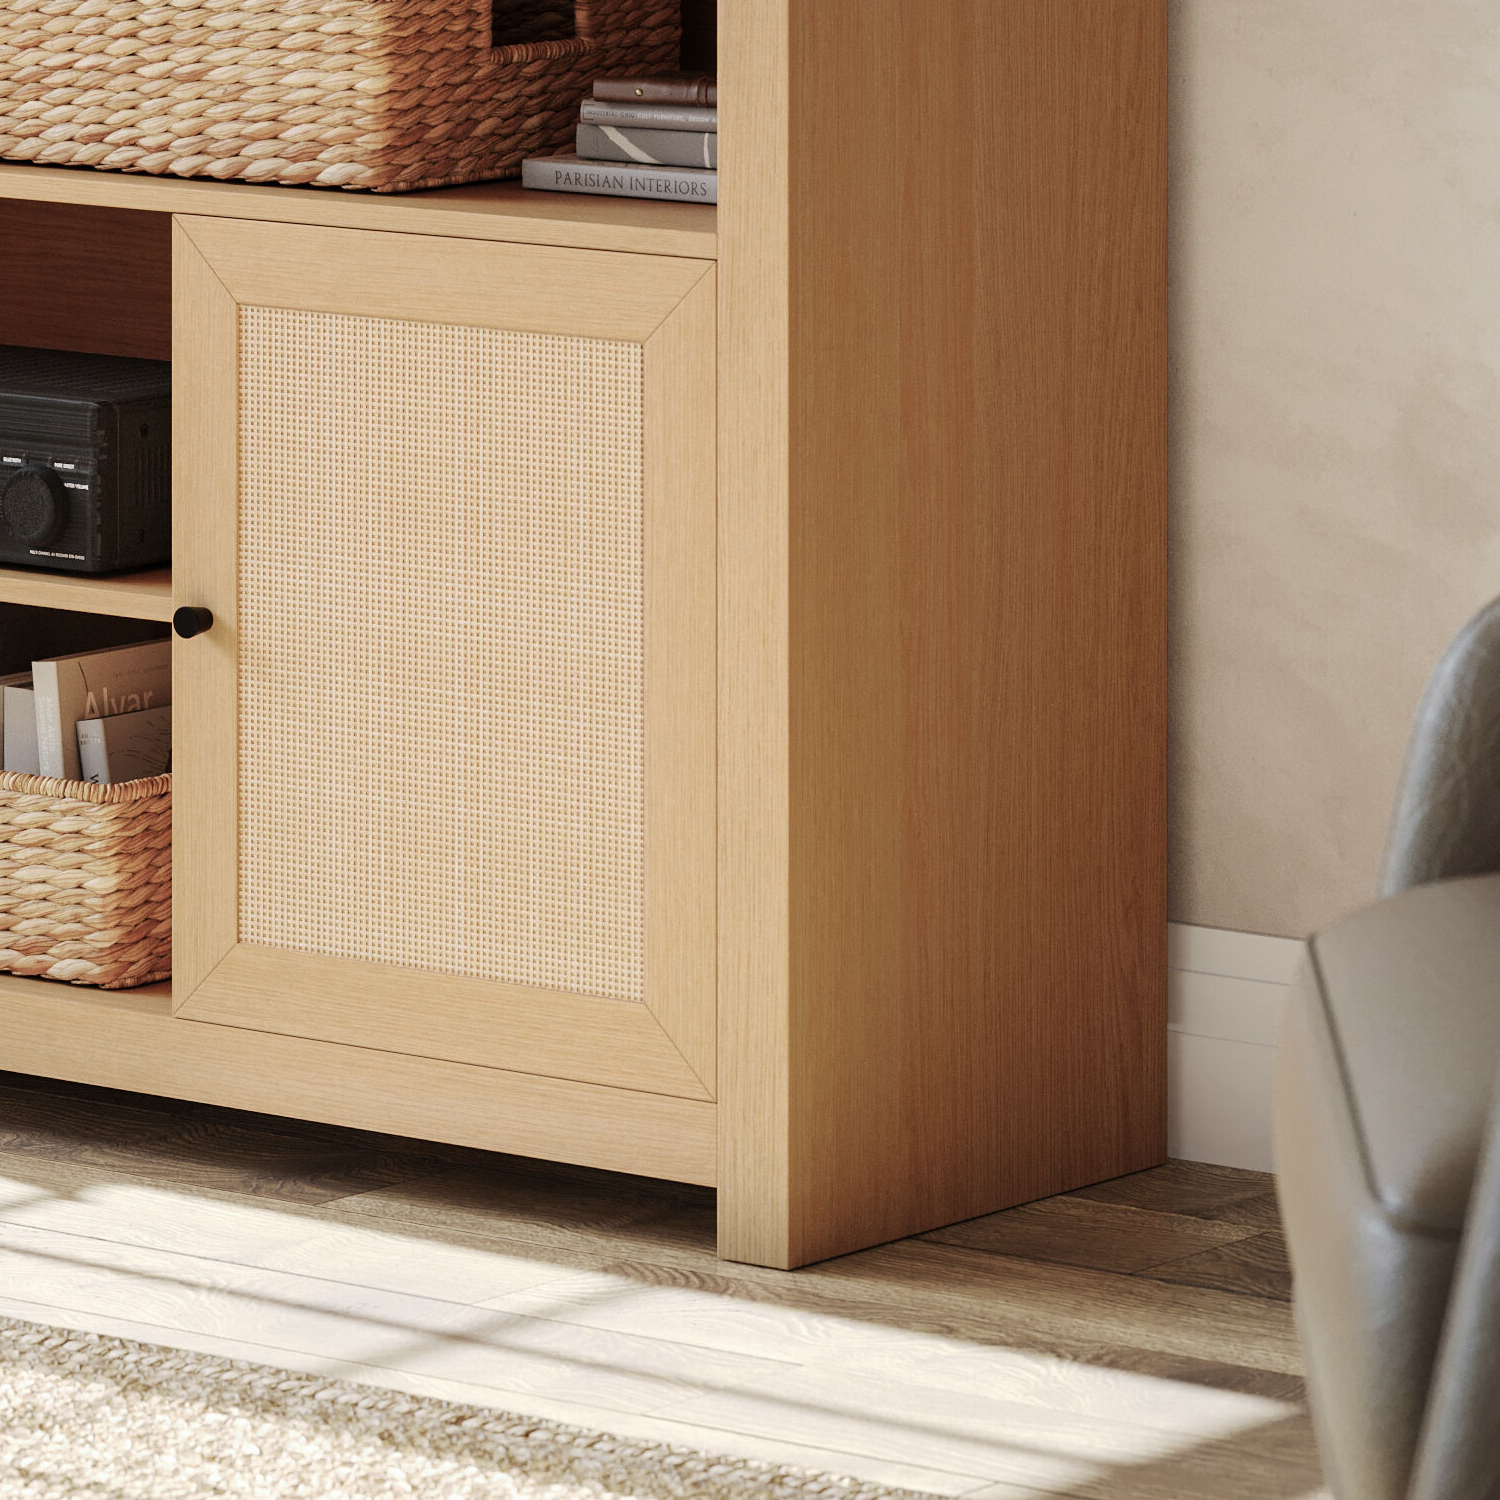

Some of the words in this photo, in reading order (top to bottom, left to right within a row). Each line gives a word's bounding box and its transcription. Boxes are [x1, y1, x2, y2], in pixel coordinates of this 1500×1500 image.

[636, 112, 652, 120] CULT
[555, 170, 624, 190] PARISIAN
[629, 177, 707, 197] INTERIORS
[85, 686, 153, 719] Alvar
